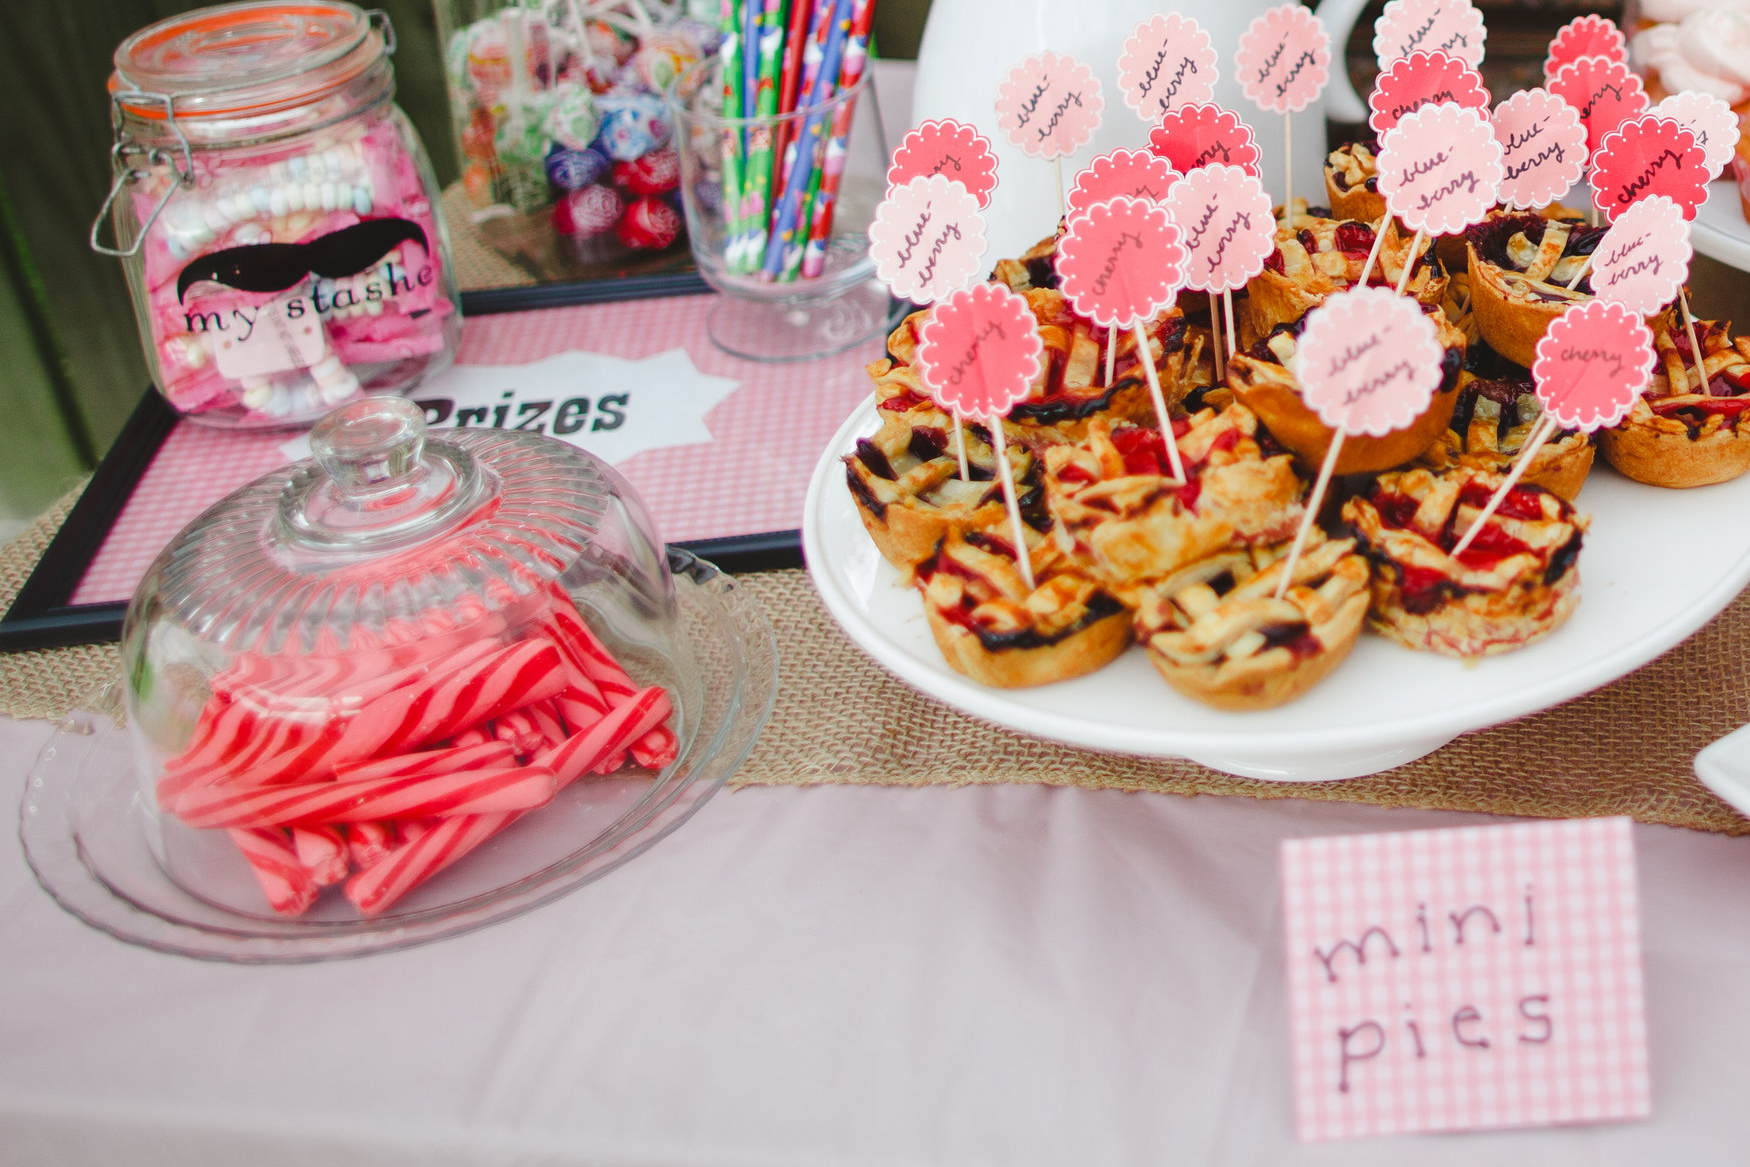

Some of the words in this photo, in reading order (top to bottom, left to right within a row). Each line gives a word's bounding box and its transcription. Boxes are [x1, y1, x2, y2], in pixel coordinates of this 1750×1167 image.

[1139, 37, 1168, 99] blue-
[1258, 31, 1288, 84] blue-
[1276, 47, 1316, 98] berry
[1018, 73, 1050, 129] blue-
[1158, 56, 1198, 116] berry
[1579, 83, 1624, 120] erry
[1037, 87, 1083, 143] berry
[1399, 144, 1455, 187] blue-
[1416, 168, 1481, 212] berry
[1504, 141, 1566, 184] berry
[1616, 146, 1684, 206] cherry
[897, 200, 932, 269] blue-
[918, 221, 962, 289] berry
[1206, 211, 1251, 274] berry
[1604, 232, 1652, 267] blue-
[1092, 229, 1143, 297] cherry
[1607, 253, 1665, 286] berry
[184, 305, 260, 342] my
[286, 261, 433, 320] stashe
[949, 319, 1006, 386] cherry
[1328, 326, 1394, 377] blue-
[1560, 345, 1624, 379] cherry
[1341, 356, 1418, 407] berry
[412, 389, 632, 436] Prizes
[1313, 882, 1536, 984] mini
[1337, 993, 1553, 1094] pies
